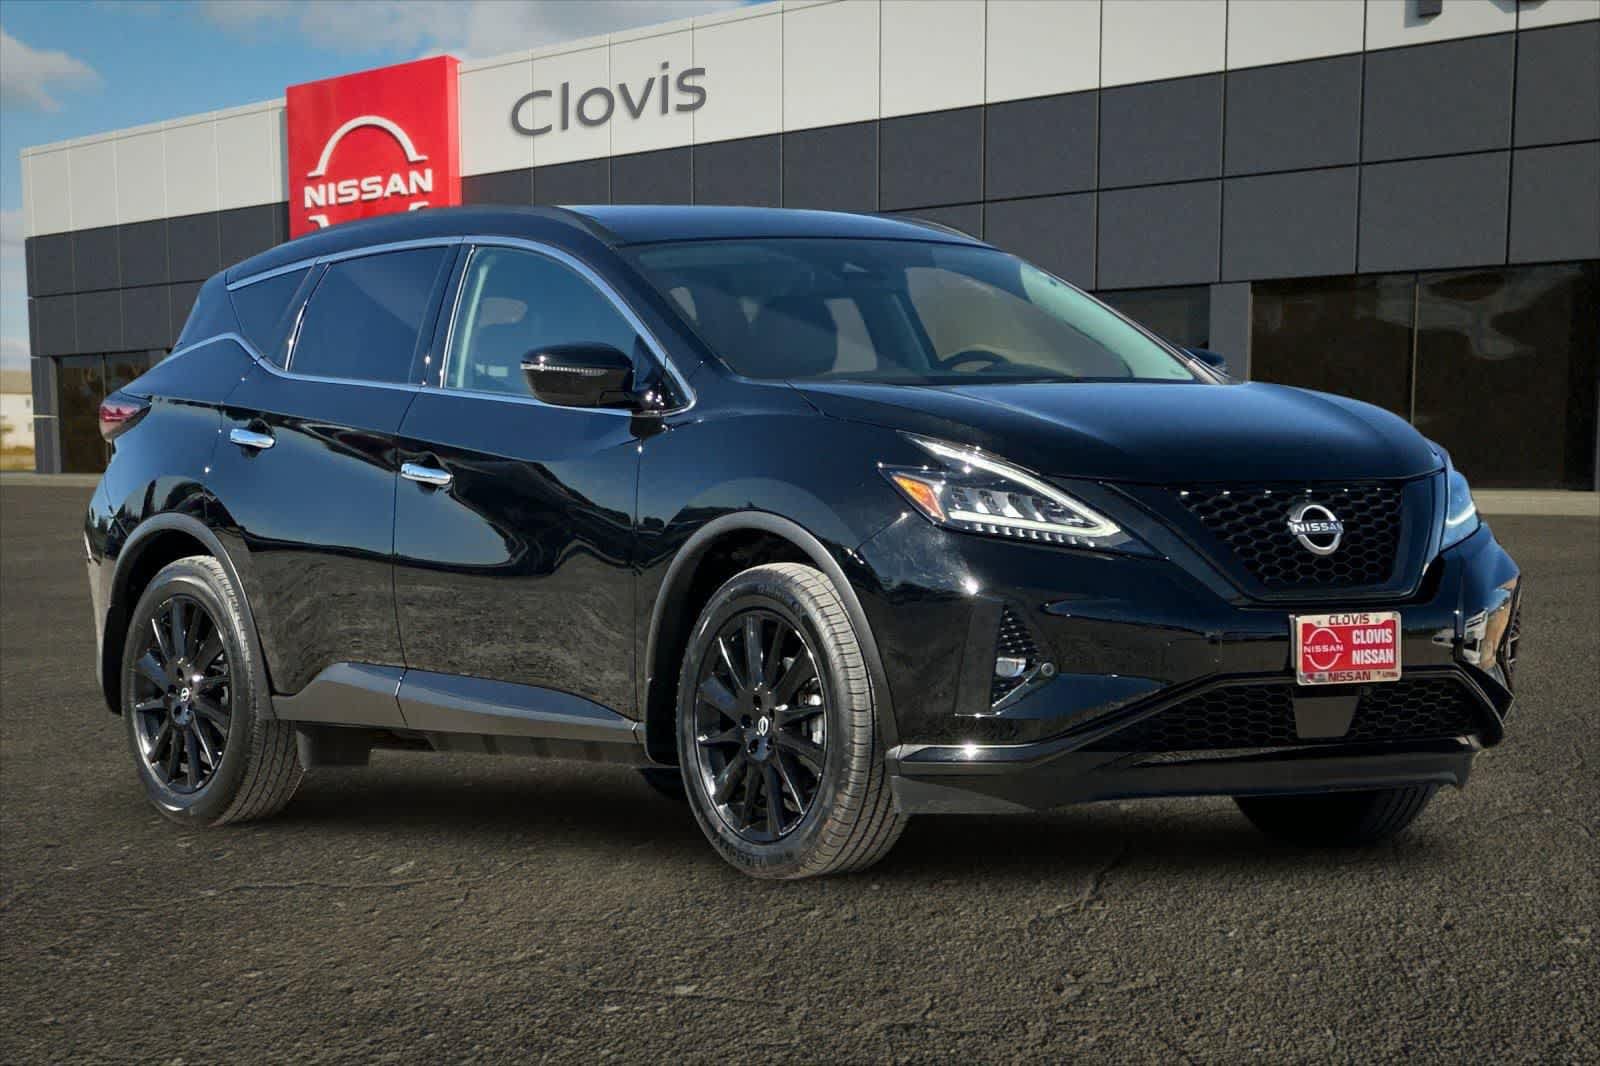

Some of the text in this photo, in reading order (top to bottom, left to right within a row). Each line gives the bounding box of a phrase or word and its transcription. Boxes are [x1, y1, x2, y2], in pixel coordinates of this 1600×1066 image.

[510, 61, 707, 136] Clovis
[304, 168, 433, 209] NISSAN
[1294, 521, 1343, 532] NISSAN
[1328, 614, 1370, 625] CLOVIS
[1352, 628, 1393, 645] CLOVIS
[1304, 644, 1344, 653] NISSAN
[1352, 648, 1394, 665] NISSAN
[1328, 671, 1371, 682] NISSAN
